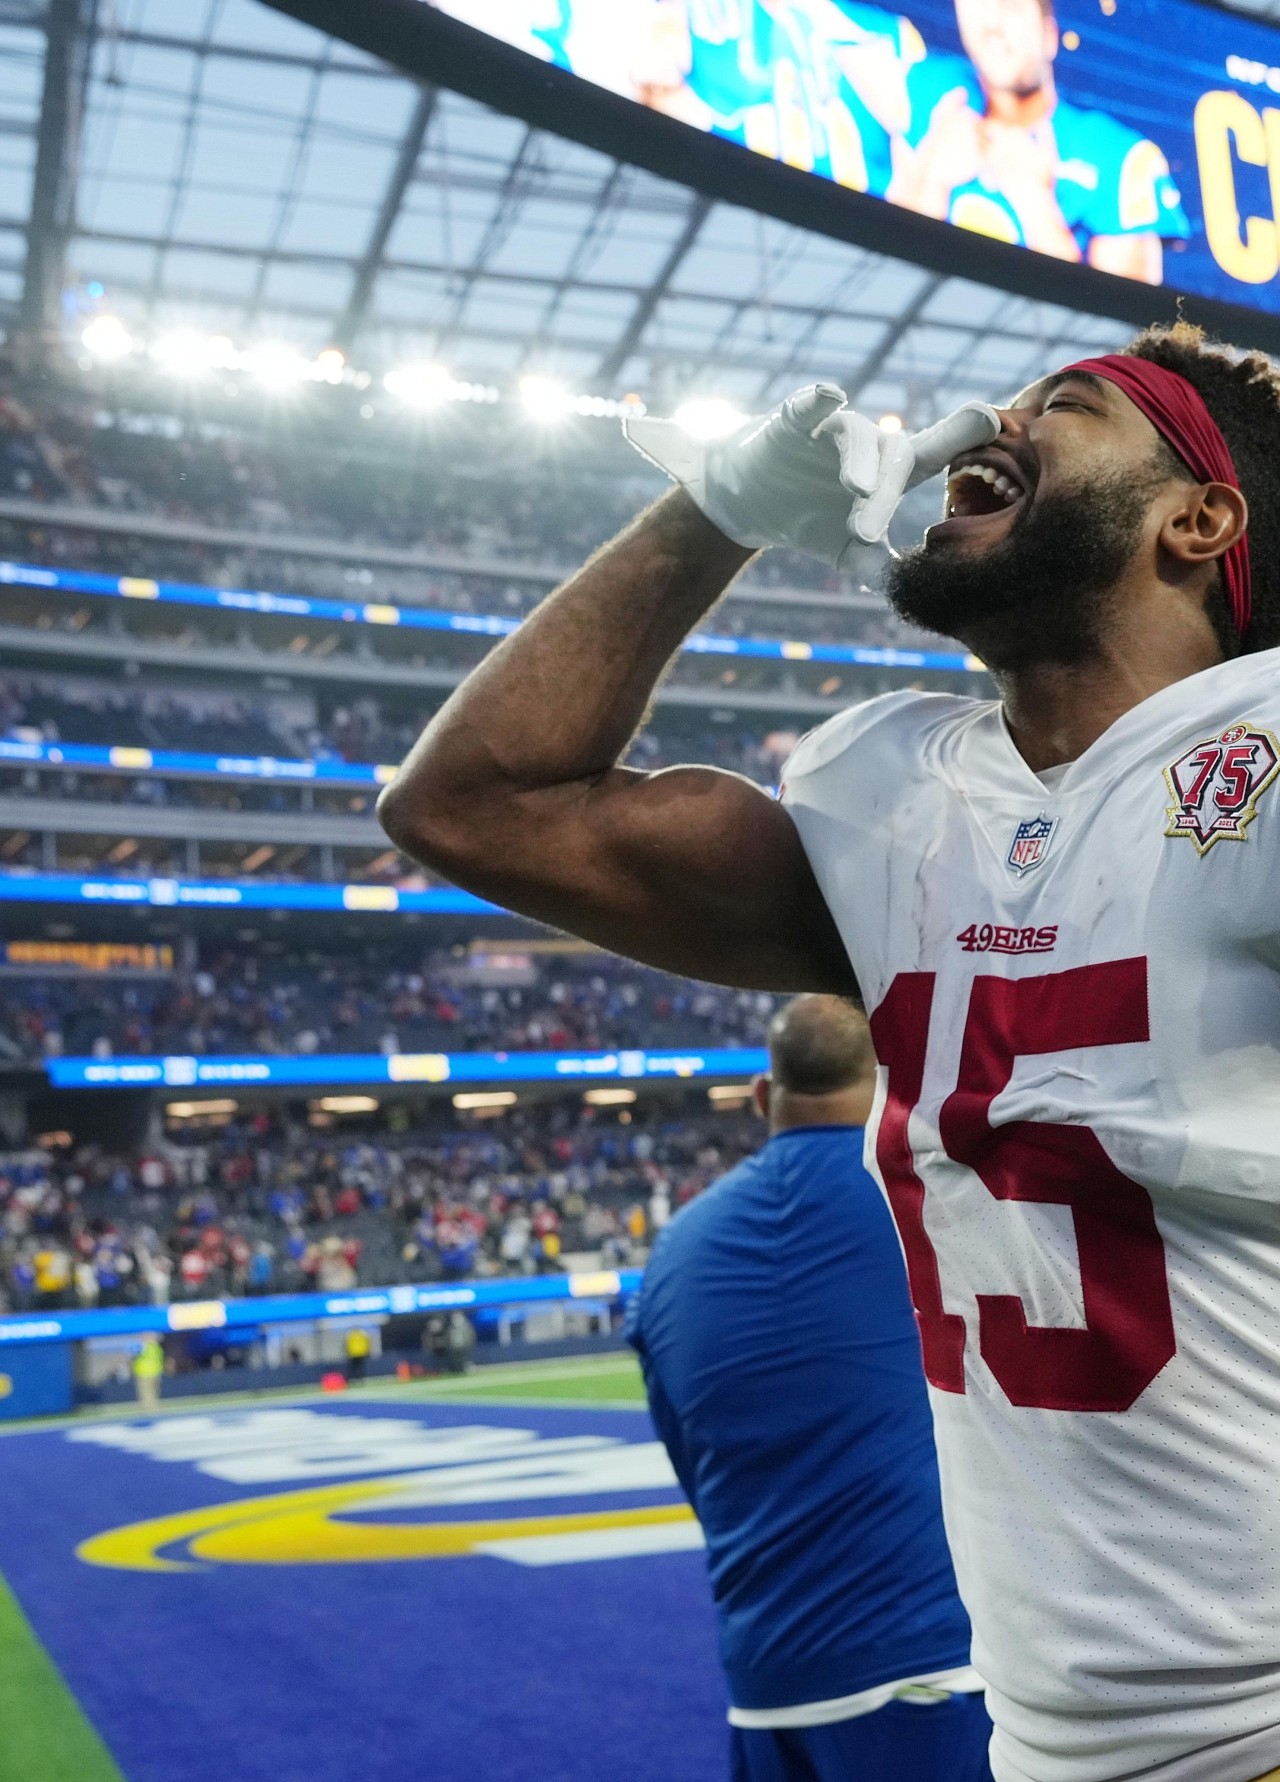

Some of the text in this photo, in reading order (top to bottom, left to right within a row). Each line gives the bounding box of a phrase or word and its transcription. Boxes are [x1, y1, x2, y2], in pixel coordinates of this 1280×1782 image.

[1182, 744, 1258, 812] 75
[1012, 839, 1041, 865] NFL
[956, 923, 1059, 955] 49ERS
[869, 955, 1176, 1412] 15
